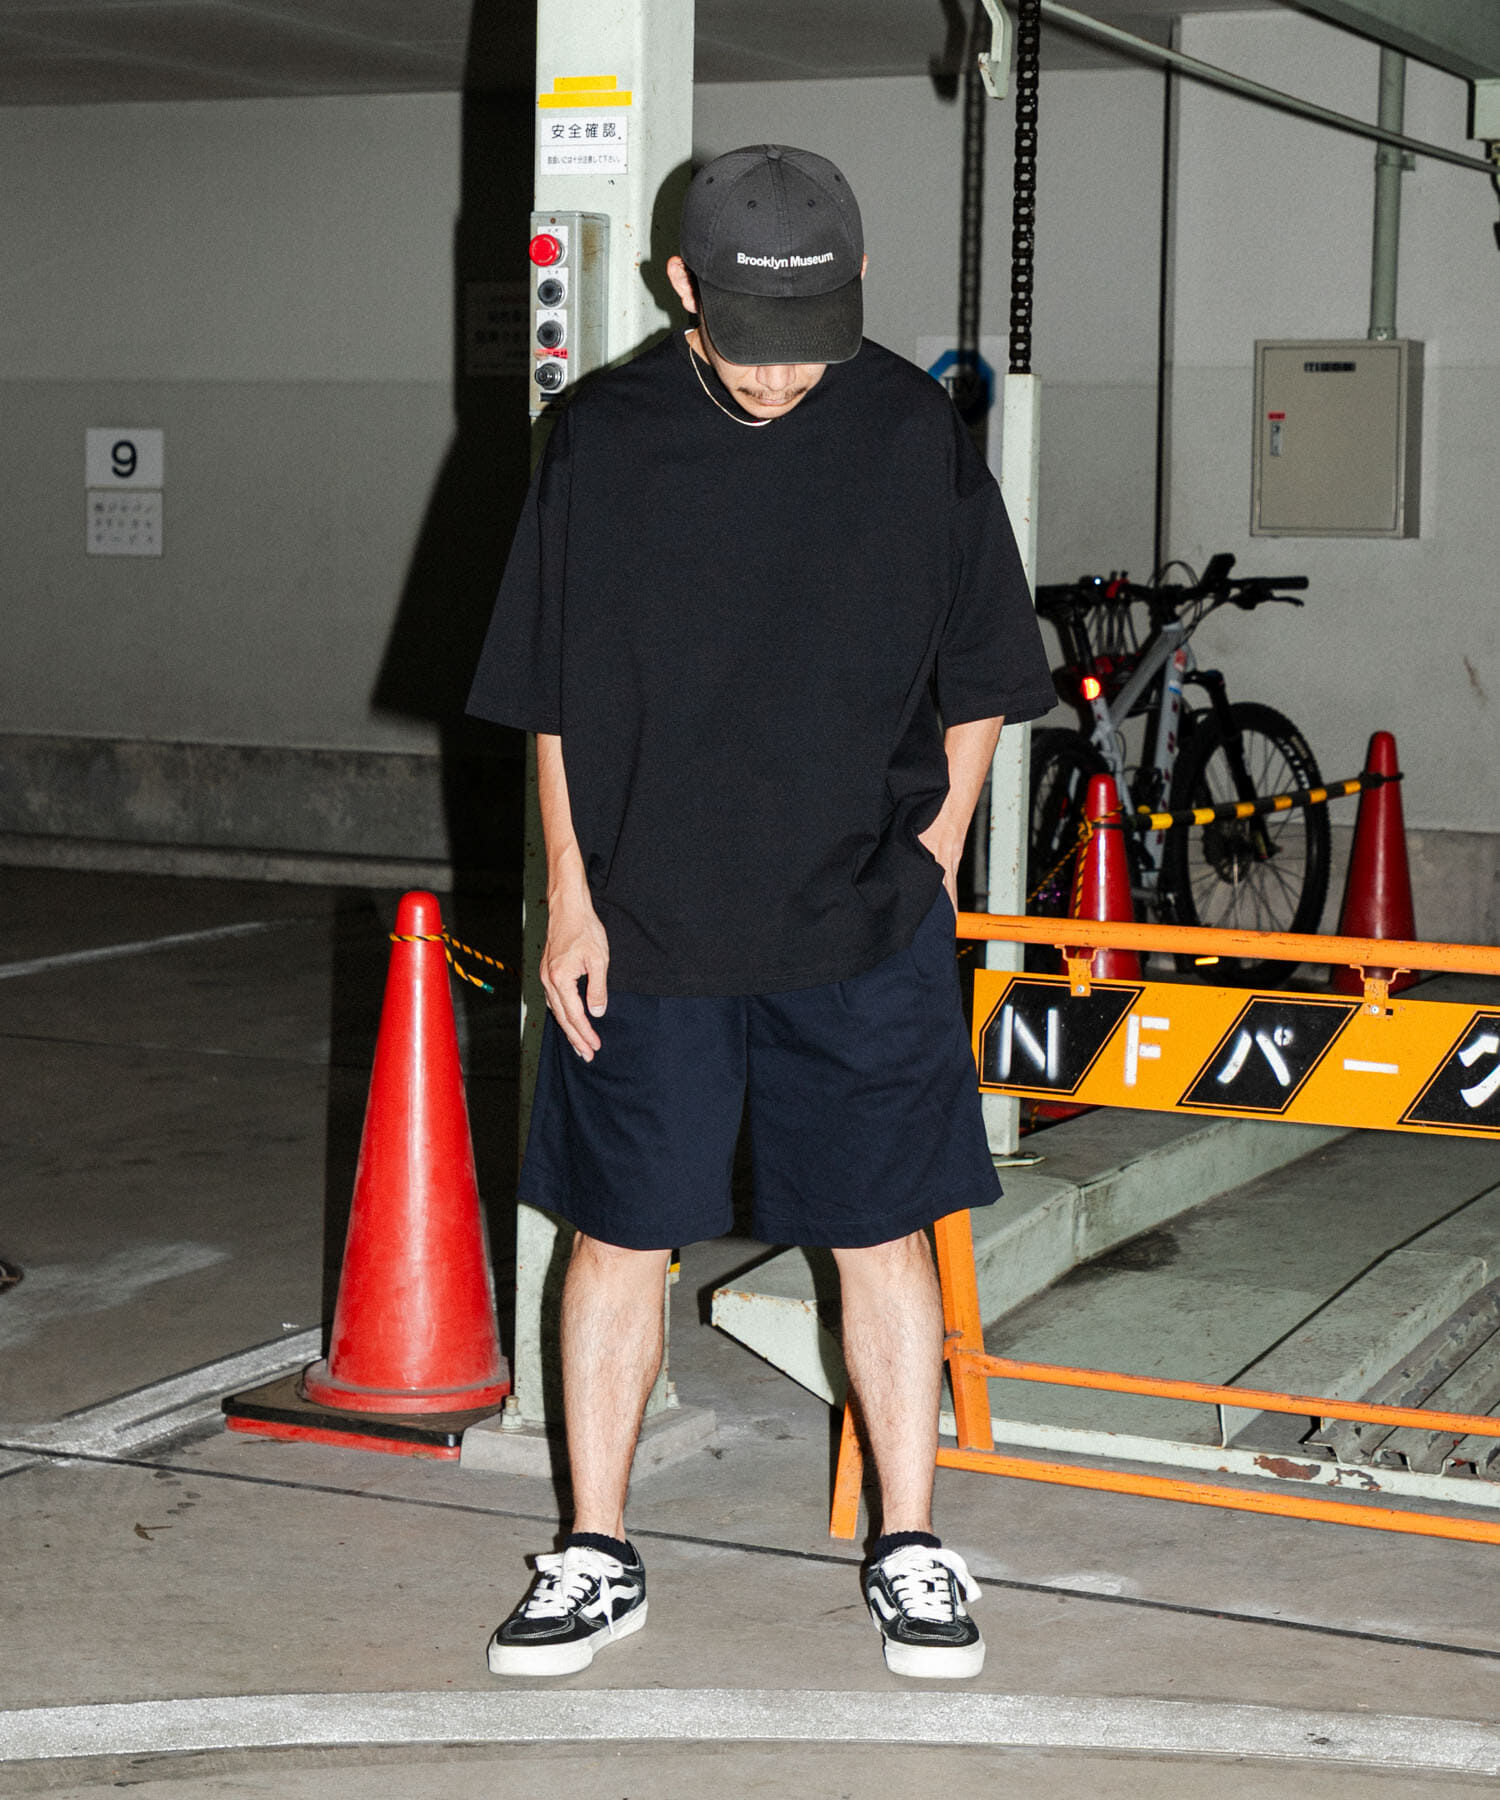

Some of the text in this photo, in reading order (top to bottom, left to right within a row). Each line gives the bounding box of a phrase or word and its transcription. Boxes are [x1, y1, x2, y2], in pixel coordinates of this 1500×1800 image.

[551, 122, 617, 139] 安全確認
[736, 251, 834, 270] Brooklyn Museum
[111, 439, 138, 478] 9
